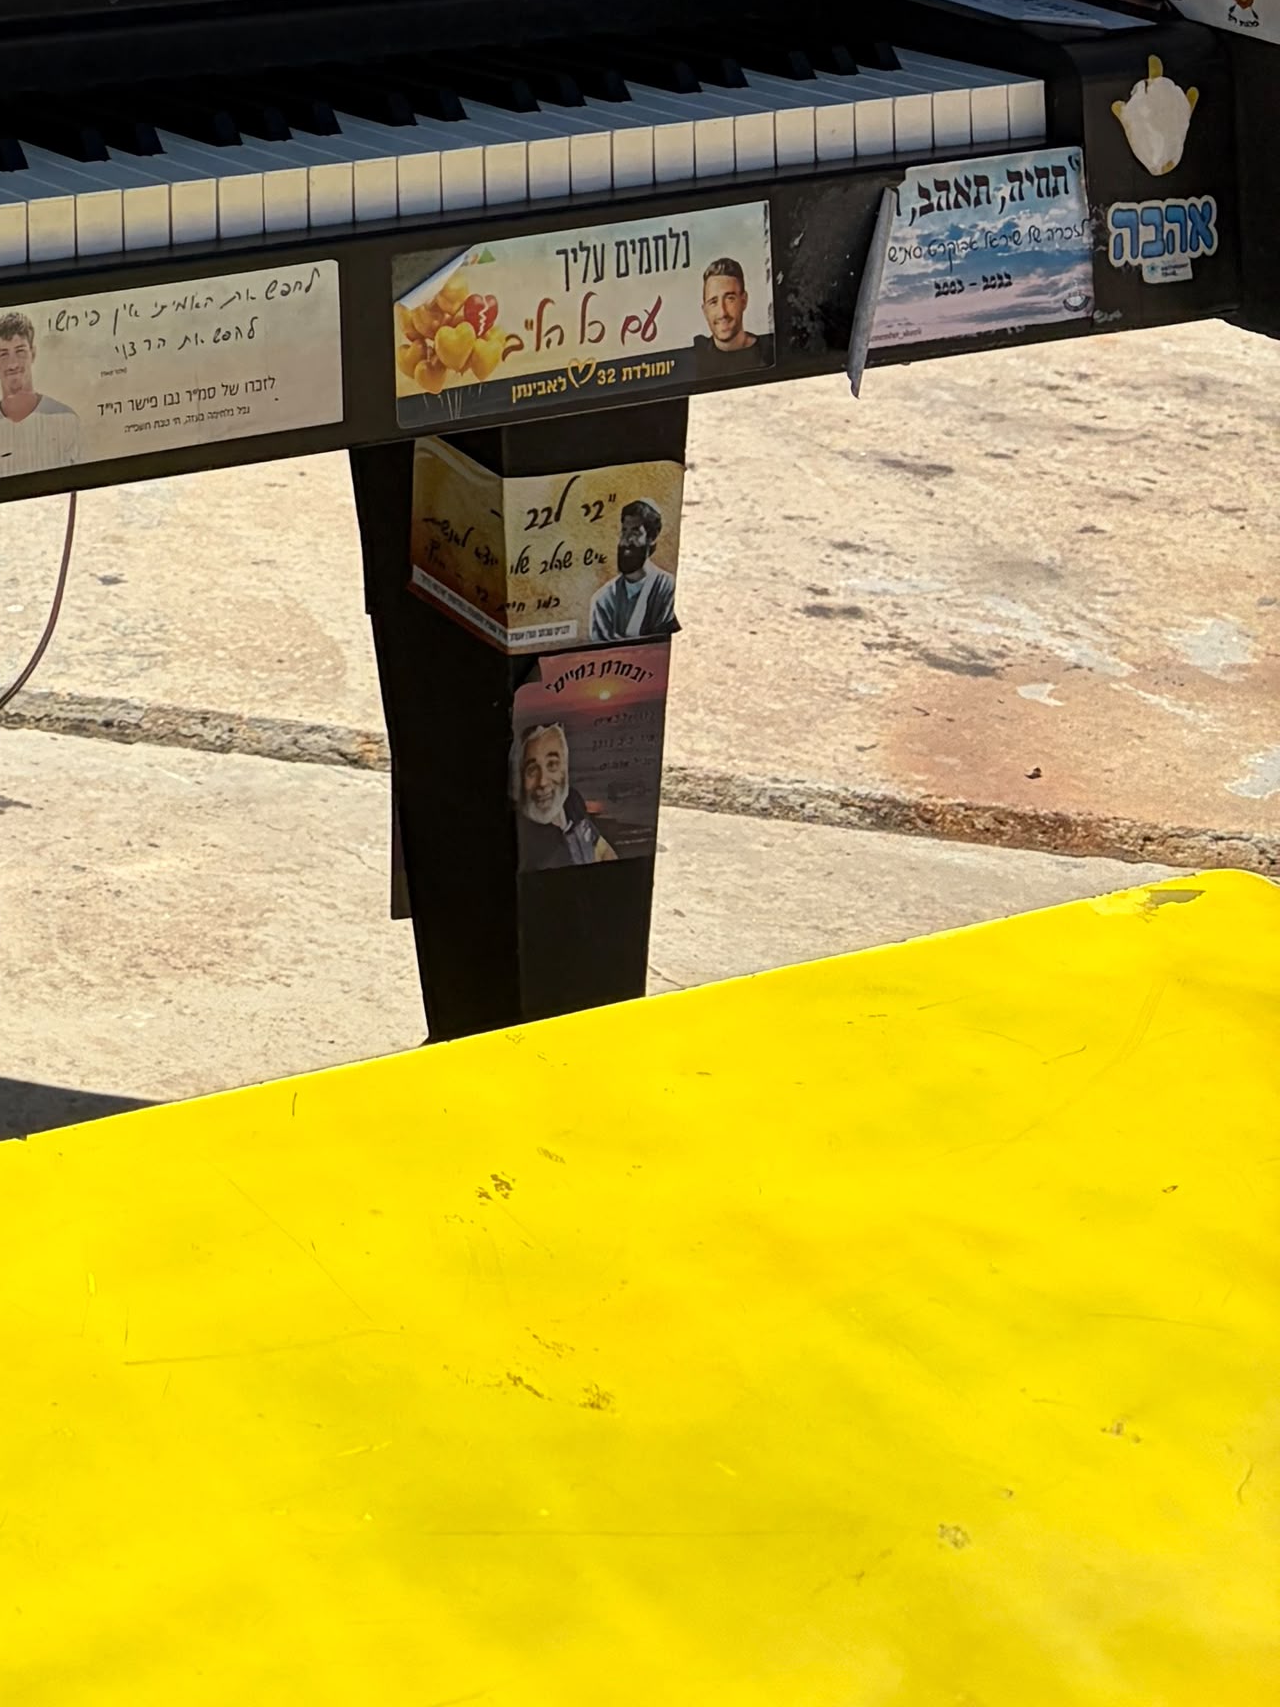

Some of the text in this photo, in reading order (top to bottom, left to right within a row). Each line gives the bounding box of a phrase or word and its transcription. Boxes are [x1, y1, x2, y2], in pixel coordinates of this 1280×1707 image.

[1111, 200, 1214, 260] אהבה
[556, 227, 690, 291] נלחמים עליך
[579, 291, 607, 346] כל
[621, 295, 662, 346] עם
[164, 392, 180, 406] נבו
[221, 383, 239, 396] של
[245, 375, 275, 393] לזכרו
[511, 360, 675, 403] יומולדת 32 לאבינתן
[128, 396, 158, 411] פישר
